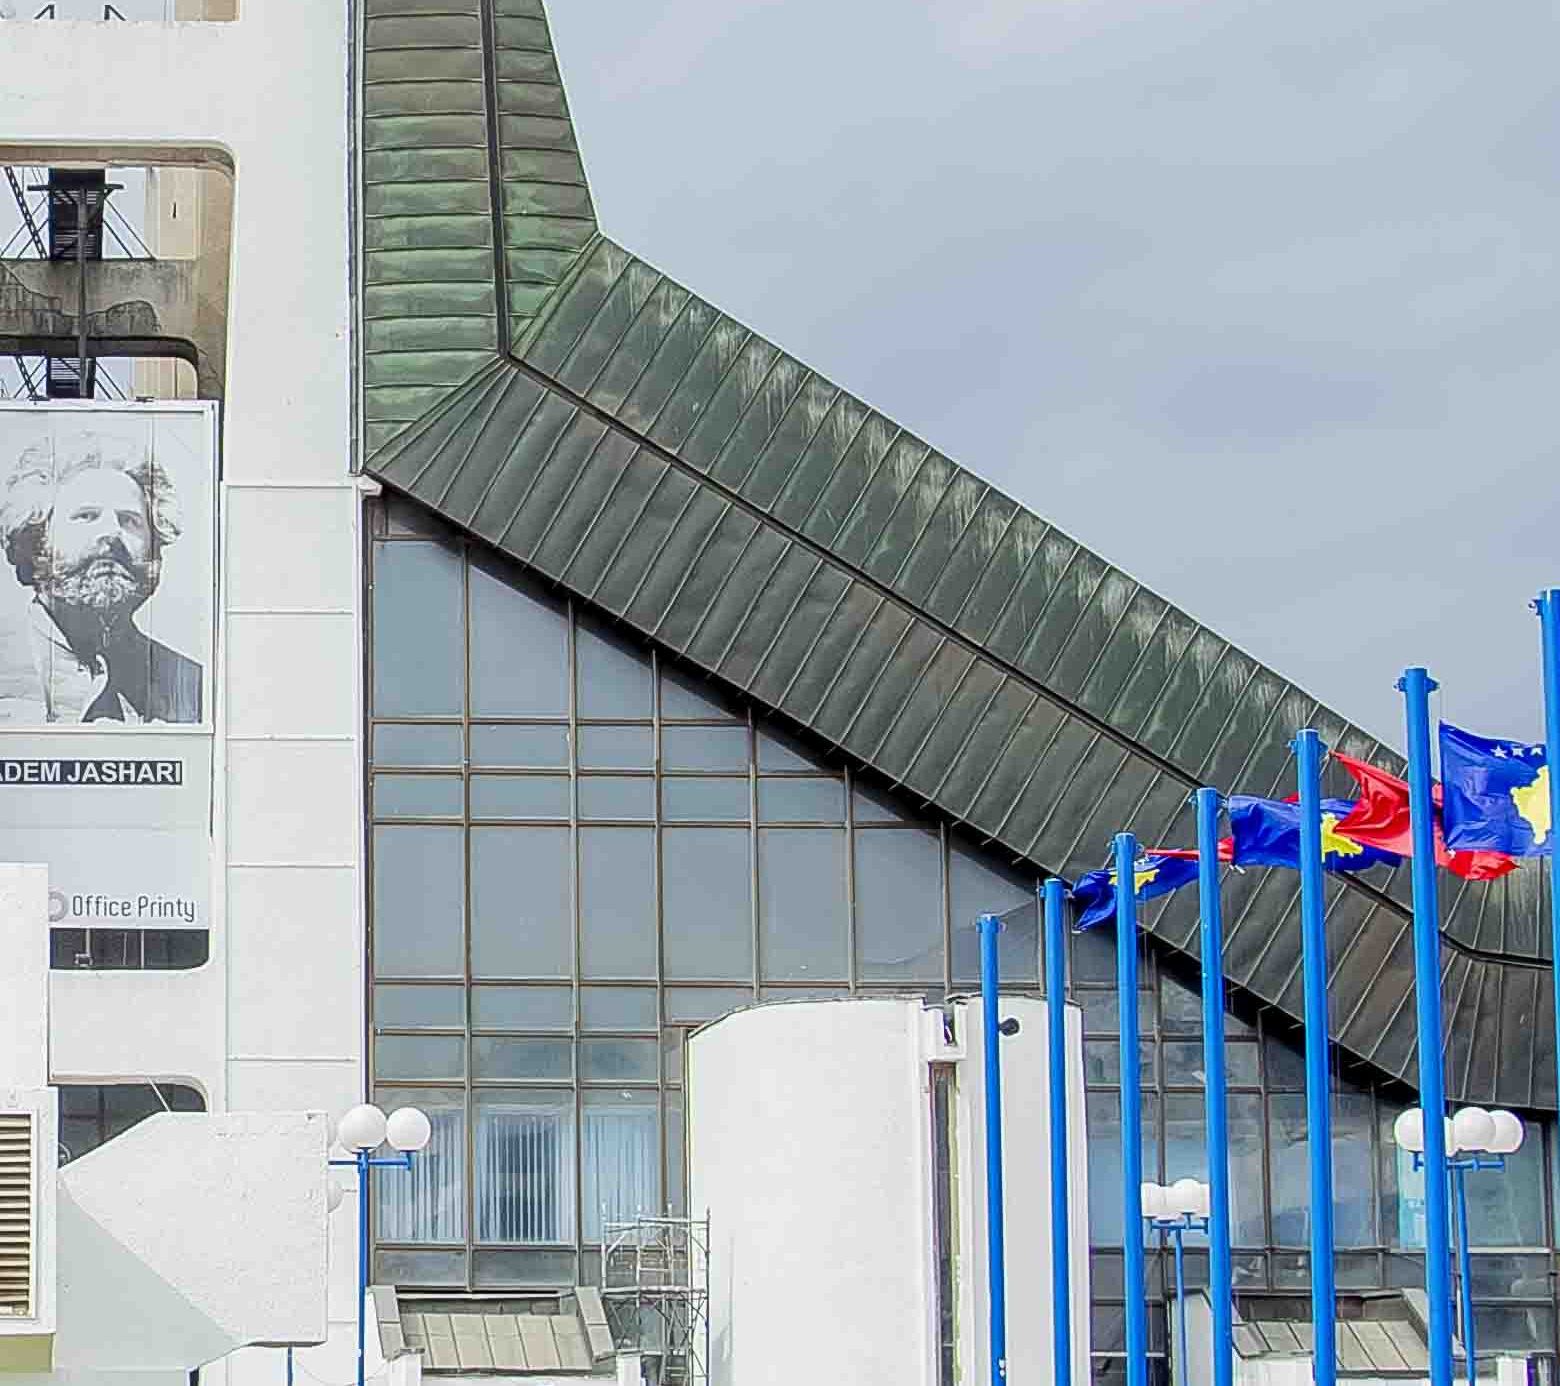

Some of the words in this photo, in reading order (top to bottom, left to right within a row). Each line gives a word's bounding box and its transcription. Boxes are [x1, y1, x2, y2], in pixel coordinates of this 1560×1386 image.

[67, 763, 181, 782] JASHARI
[72, 895, 131, 917] Office
[138, 895, 195, 923] Printy
